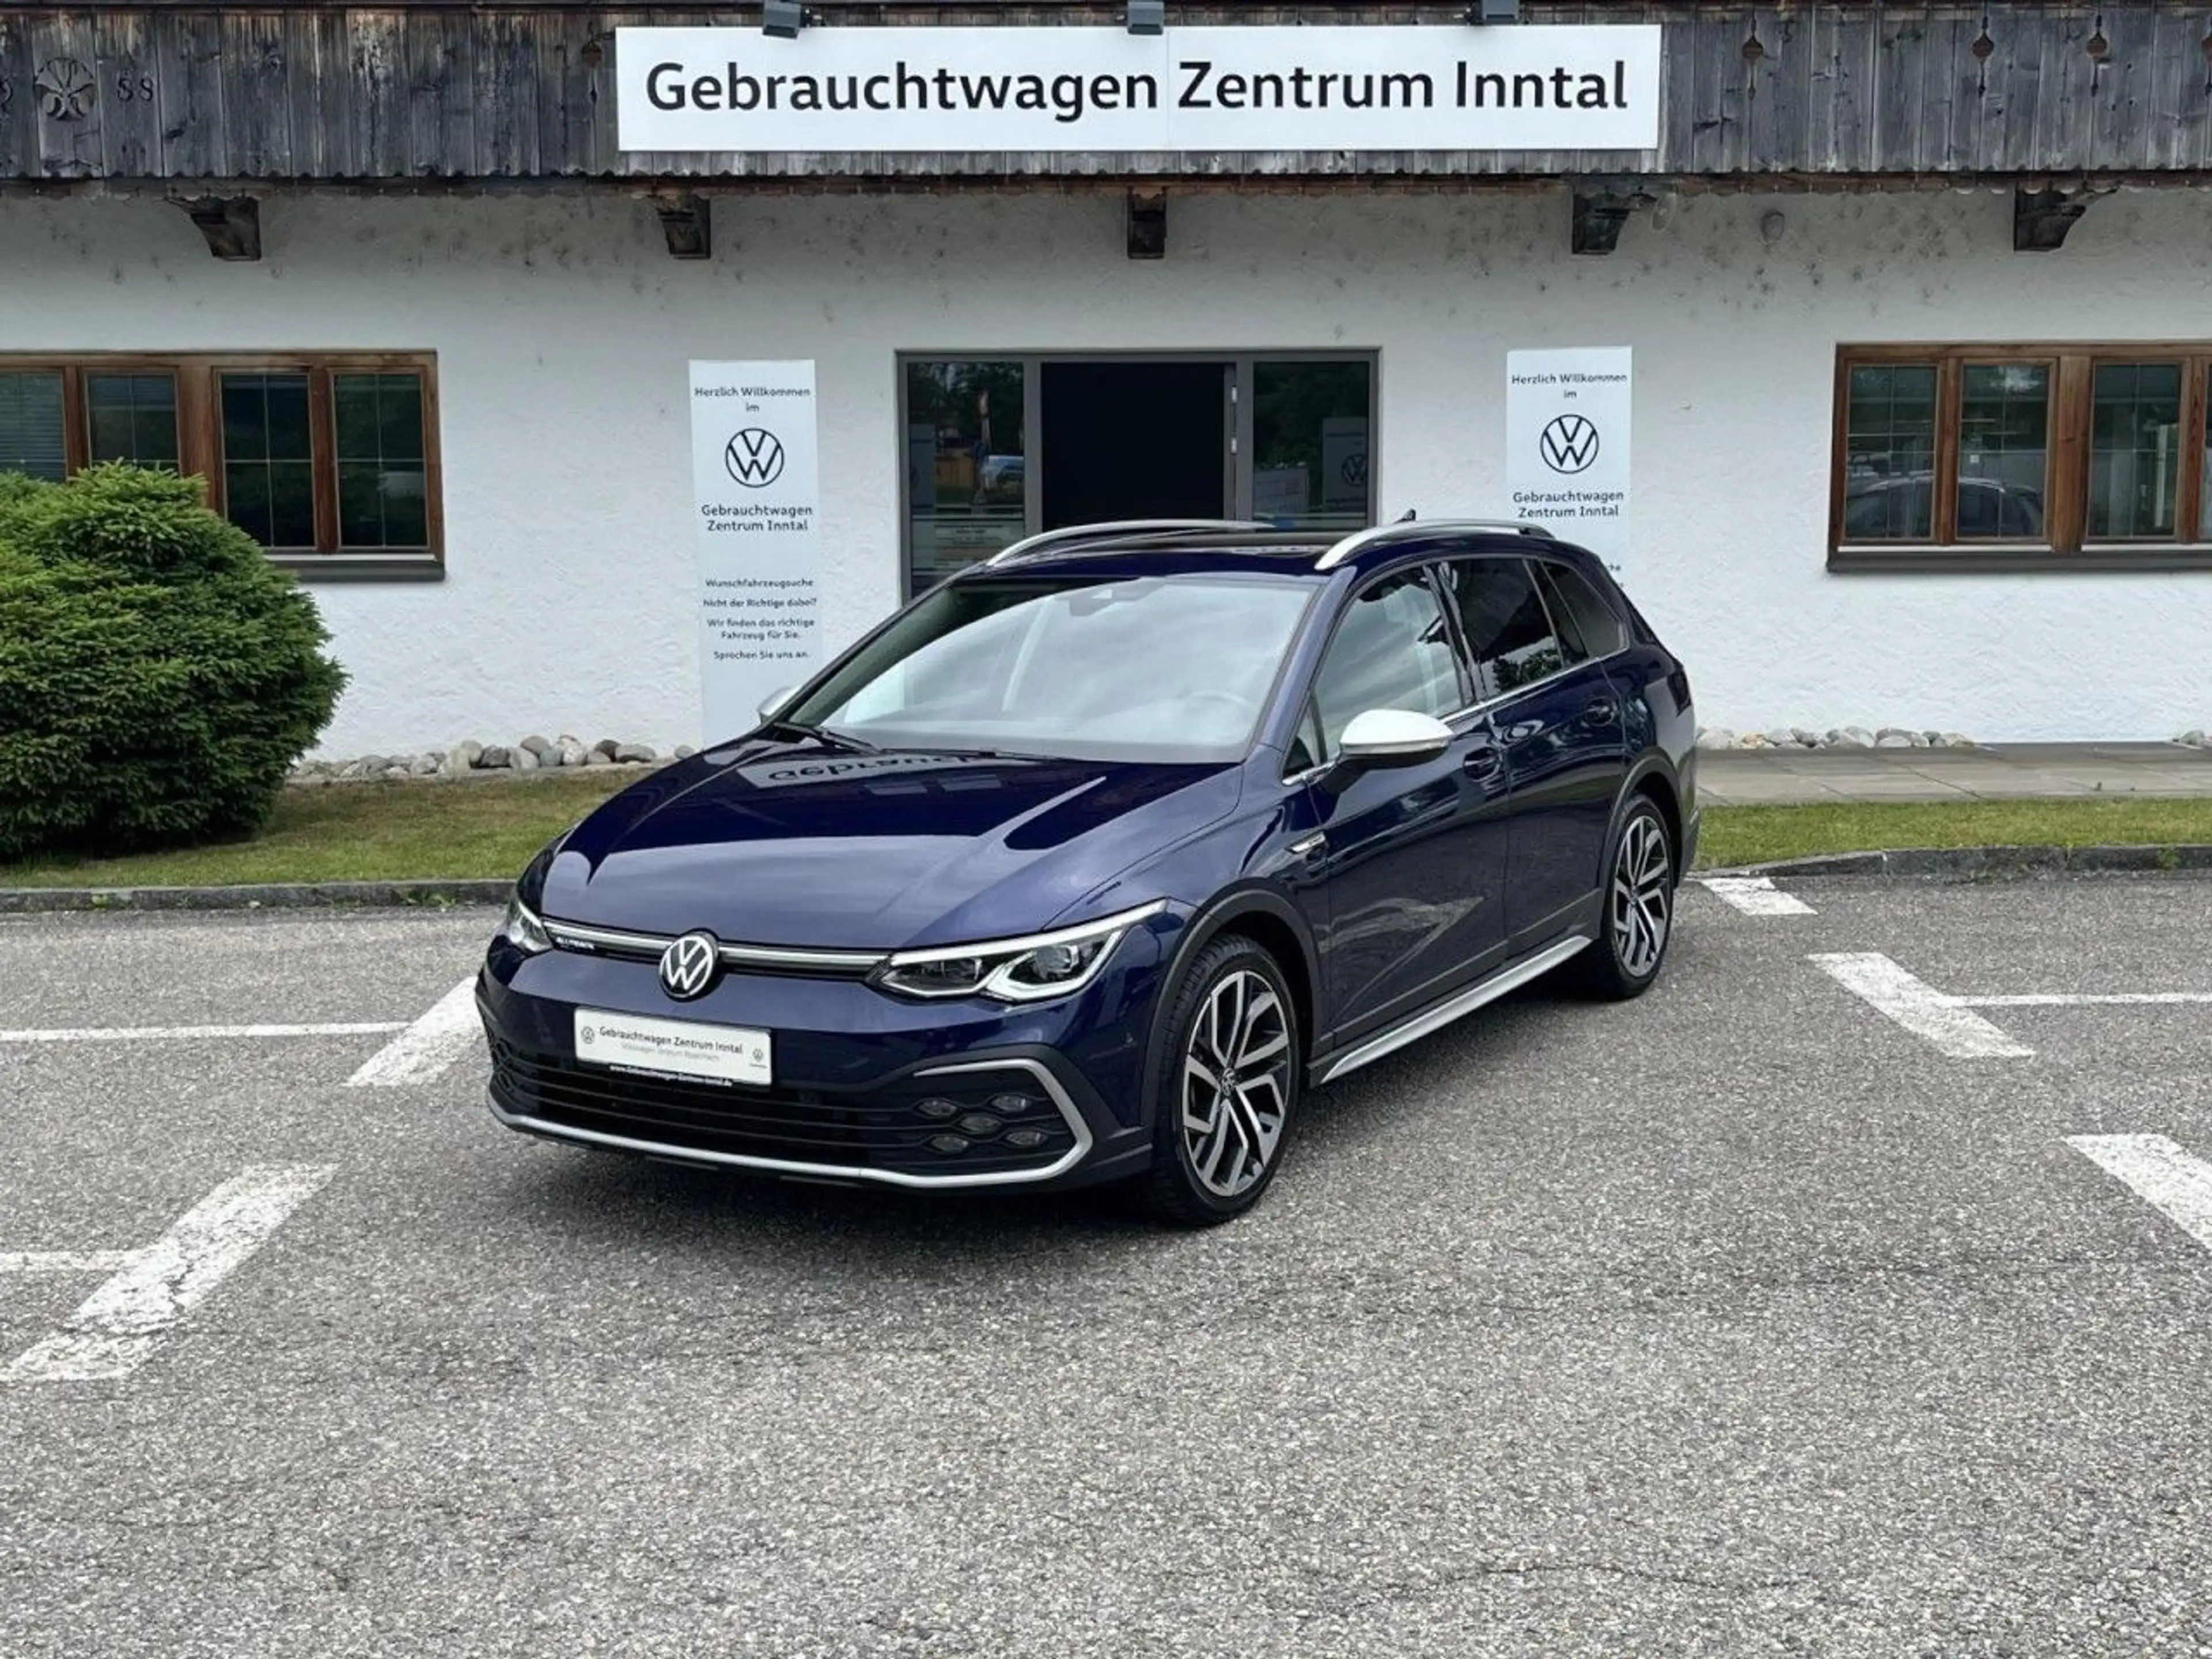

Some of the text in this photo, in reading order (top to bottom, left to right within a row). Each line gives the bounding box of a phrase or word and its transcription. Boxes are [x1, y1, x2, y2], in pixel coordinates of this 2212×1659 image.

[646, 60, 1627, 123] Gebrauchtwagen Zentrum Inntal
[1512, 373, 1627, 384] Herzlich Willkommen
[694, 387, 810, 396] Herzlich Willkommen
[1563, 390, 1577, 399] im
[746, 402, 760, 412] im
[1513, 491, 1624, 503] Gebrauchtwagen
[701, 503, 813, 518] Gebrauchtwagen
[1518, 505, 1619, 518] Zentrum Inntal
[707, 520, 808, 531] Zentrum Inntal
[705, 578, 814, 589] Wunschfahrzeugsuche
[730, 599, 745, 607] der
[707, 619, 724, 627] Wir
[759, 618, 775, 627] das
[778, 618, 815, 628] richtige
[721, 631, 764, 641] Fahrzeug
[599, 1025, 743, 1054] Gebrauchtwagen Zentrum Inntal
